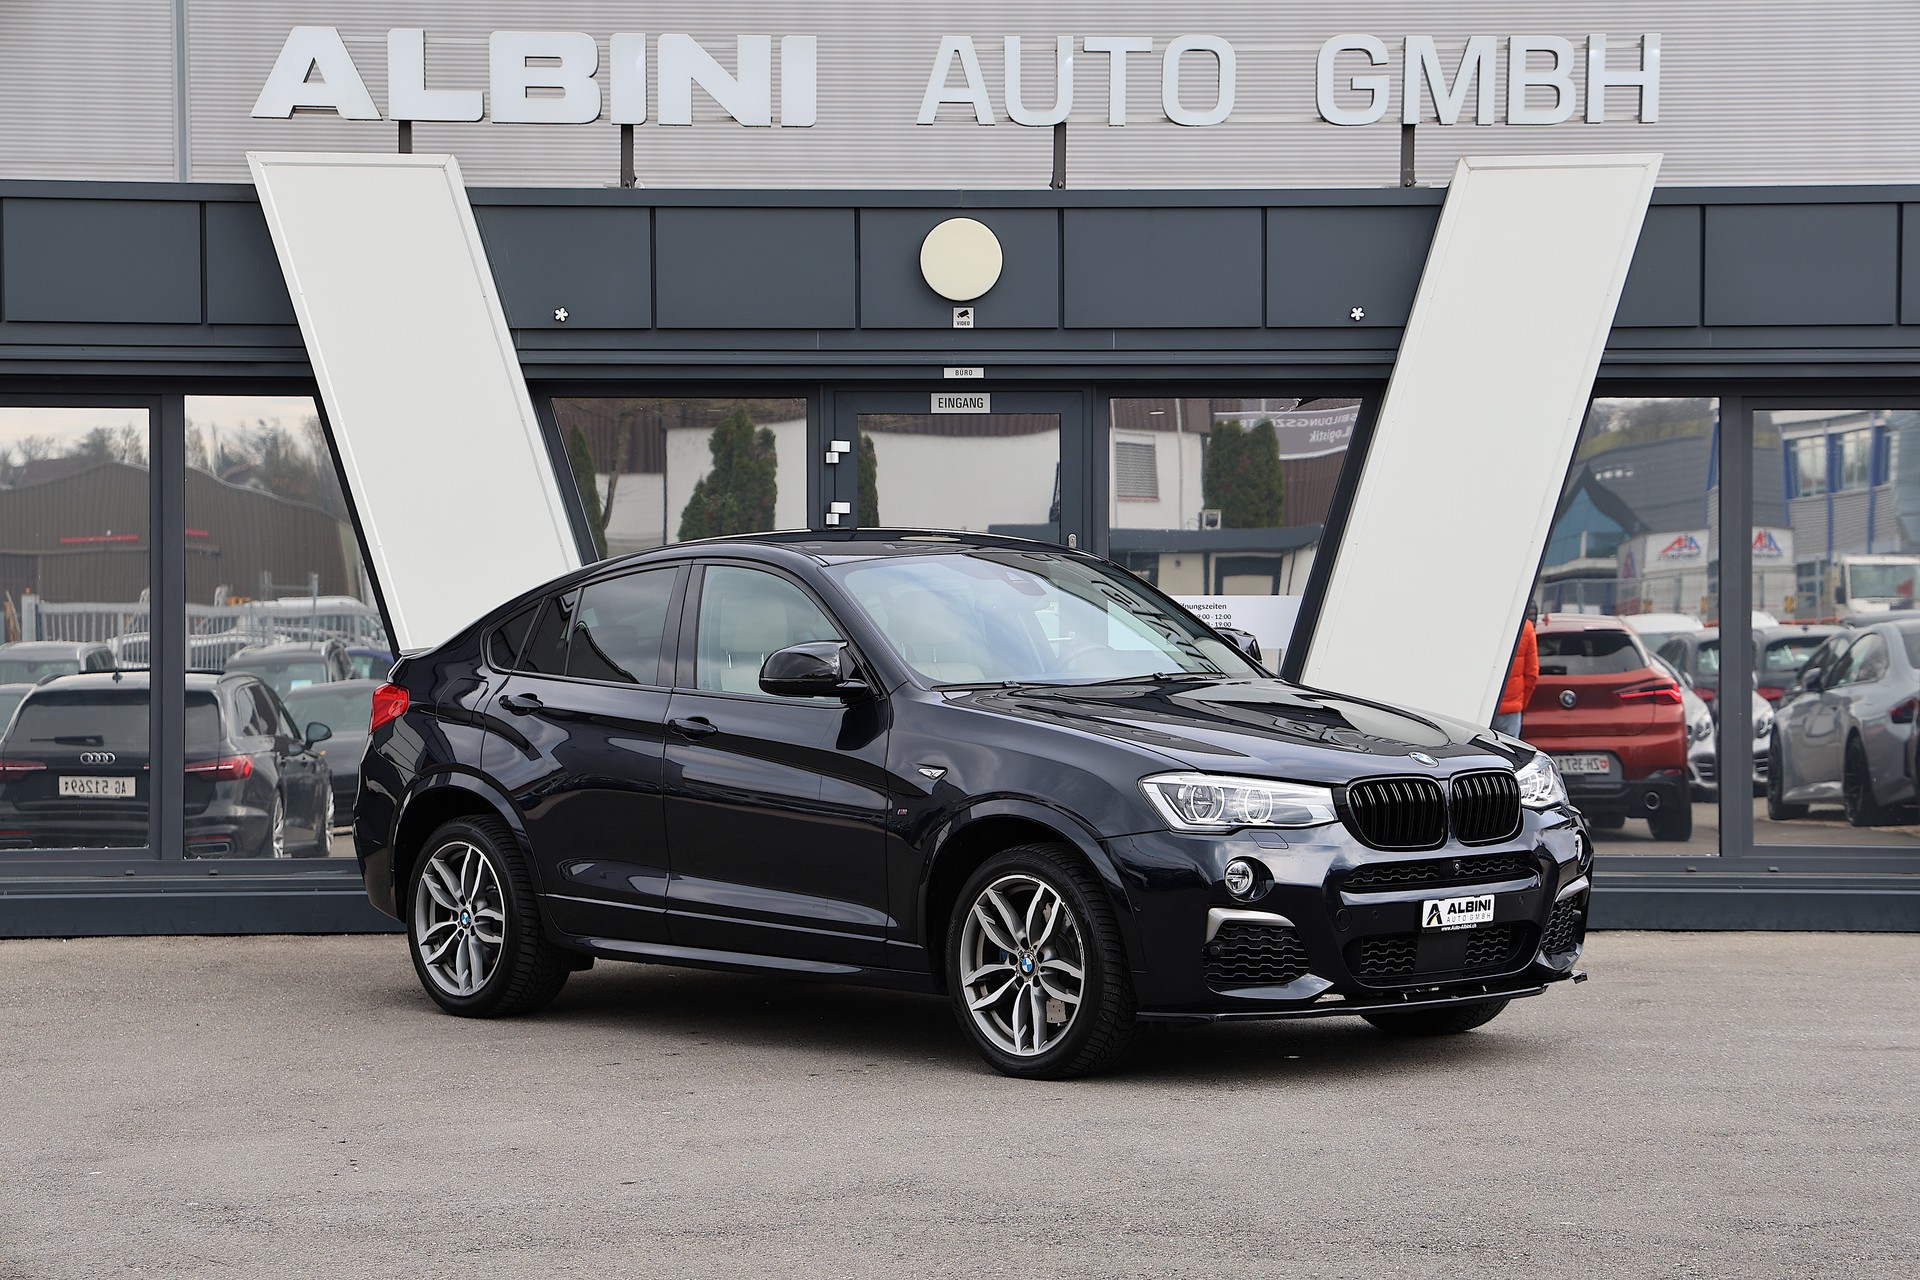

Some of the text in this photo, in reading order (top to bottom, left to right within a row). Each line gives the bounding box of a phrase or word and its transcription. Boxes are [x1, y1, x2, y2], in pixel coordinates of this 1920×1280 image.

[250, 26, 1662, 127] ALBINI AUTO GMBH
[938, 397, 984, 408] EINGANG
[1447, 899, 1491, 915] ALBINI
[1446, 913, 1491, 923] AUTO GMBH
